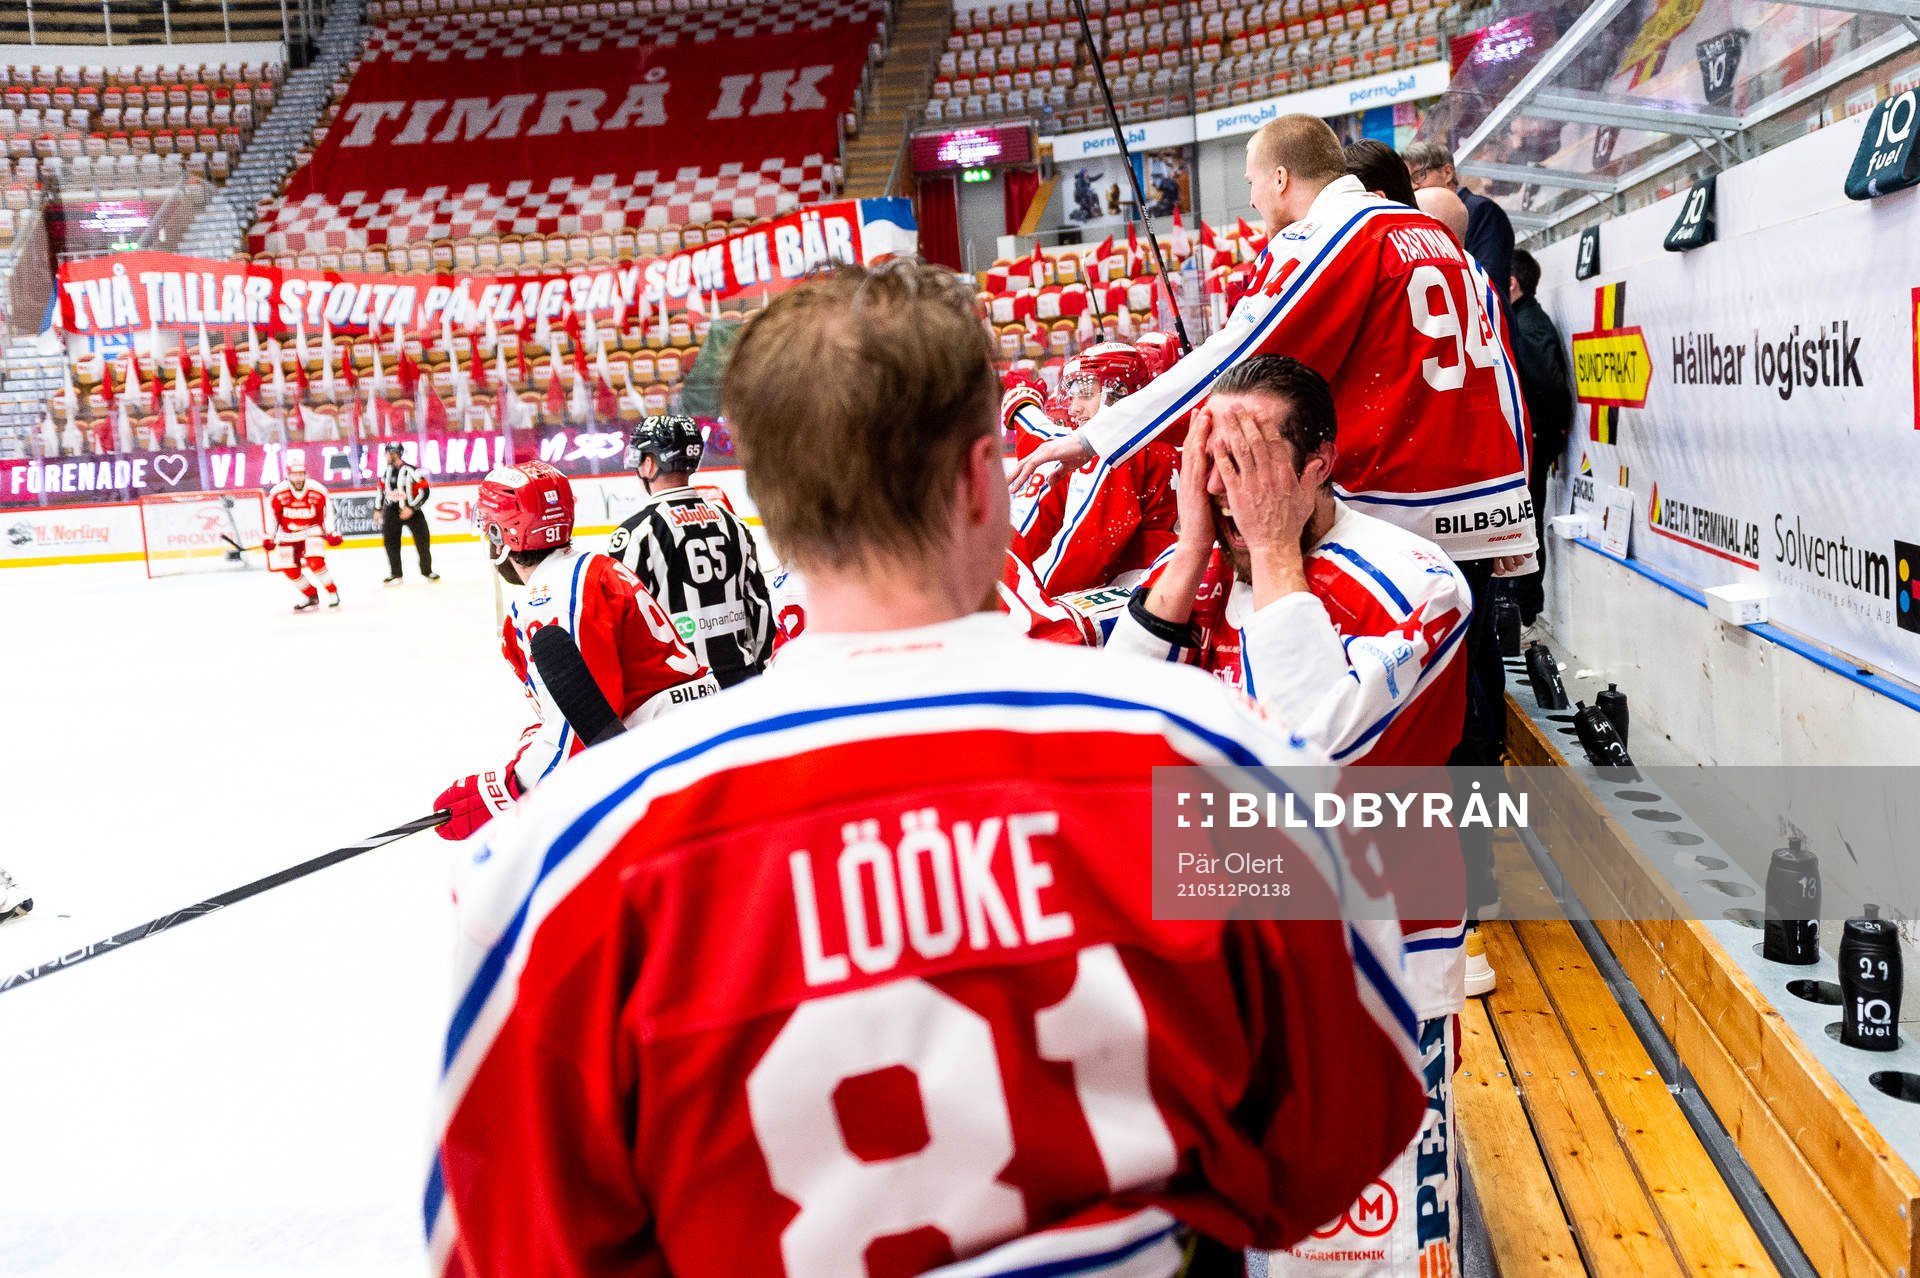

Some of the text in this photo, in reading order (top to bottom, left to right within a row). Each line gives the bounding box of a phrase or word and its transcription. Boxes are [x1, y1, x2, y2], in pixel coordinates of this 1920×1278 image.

[339, 66, 671, 148] TIMRÅ
[707, 64, 834, 121] IK
[1348, 75, 1416, 103] permobil
[1216, 104, 1277, 132] permobil
[1874, 90, 1917, 148] iQ
[1866, 142, 1902, 177] fuel
[63, 262, 141, 331] TVÅ
[139, 271, 274, 325] TALLAR
[278, 278, 416, 328] STOLTA
[644, 243, 726, 303] SOM
[729, 231, 773, 286] VI
[774, 210, 856, 280] BÄR
[1672, 319, 1865, 401] Hållbar logistik
[686, 444, 701, 456] 65
[11, 458, 149, 495] FÖRENADE
[211, 452, 246, 489] VI
[670, 503, 720, 529] Sibylla
[1664, 498, 1760, 560] DELTA TERMINAL AB
[546, 527, 561, 543] 91
[685, 536, 727, 584] 65
[1774, 513, 1891, 600] Solventum
[789, 806, 1074, 987] LÖÖKE
[1858, 956, 1890, 982] 29
[1856, 995, 1892, 1025] iQ
[1857, 1023, 1892, 1037] fuel
[746, 943, 1179, 1278] 81
[1358, 1193, 1384, 1222] M
